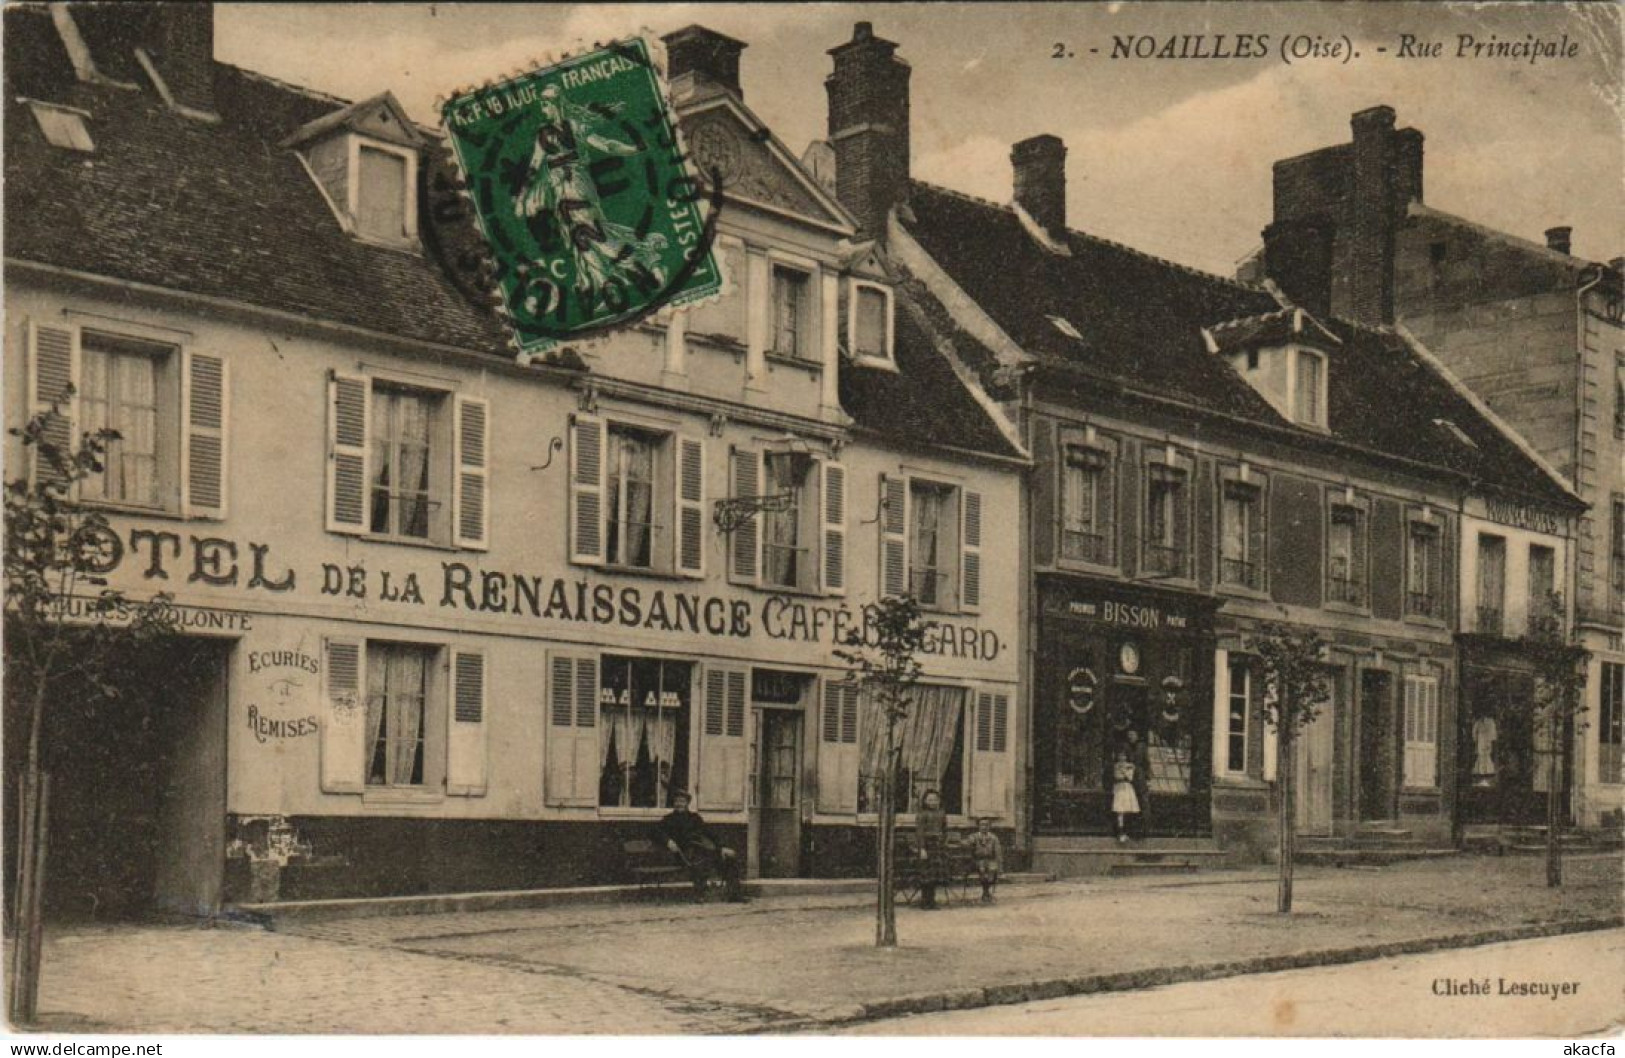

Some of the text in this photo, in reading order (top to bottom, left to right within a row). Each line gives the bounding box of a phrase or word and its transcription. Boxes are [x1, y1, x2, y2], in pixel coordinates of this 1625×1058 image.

[560, 54, 643, 91] FRANÇAIS
[320, 562, 368, 599] DE
[379, 569, 426, 605] LA
[439, 561, 752, 638] RENAISSANCE
[761, 596, 852, 646] CAFÉ
[1103, 600, 1161, 630] BISSON
[248, 651, 320, 674] ECURIES
[247, 704, 319, 744] REMISES
